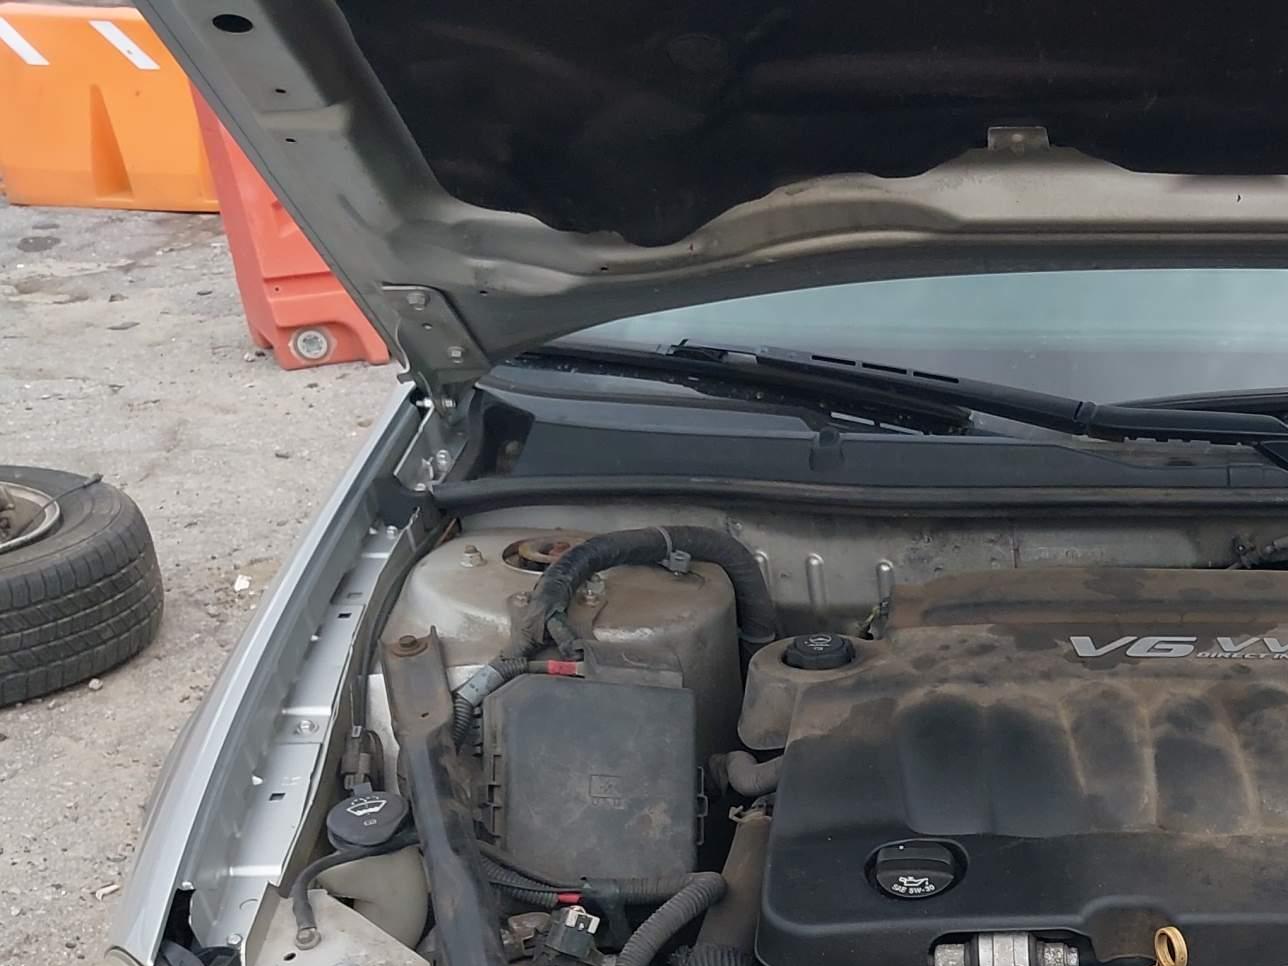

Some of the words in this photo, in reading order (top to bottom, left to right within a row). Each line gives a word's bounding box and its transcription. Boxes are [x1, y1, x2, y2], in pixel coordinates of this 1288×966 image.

[1069, 635, 1197, 658] V6
[1196, 651, 1266, 660] DIRECT
[891, 883, 908, 893] SAE
